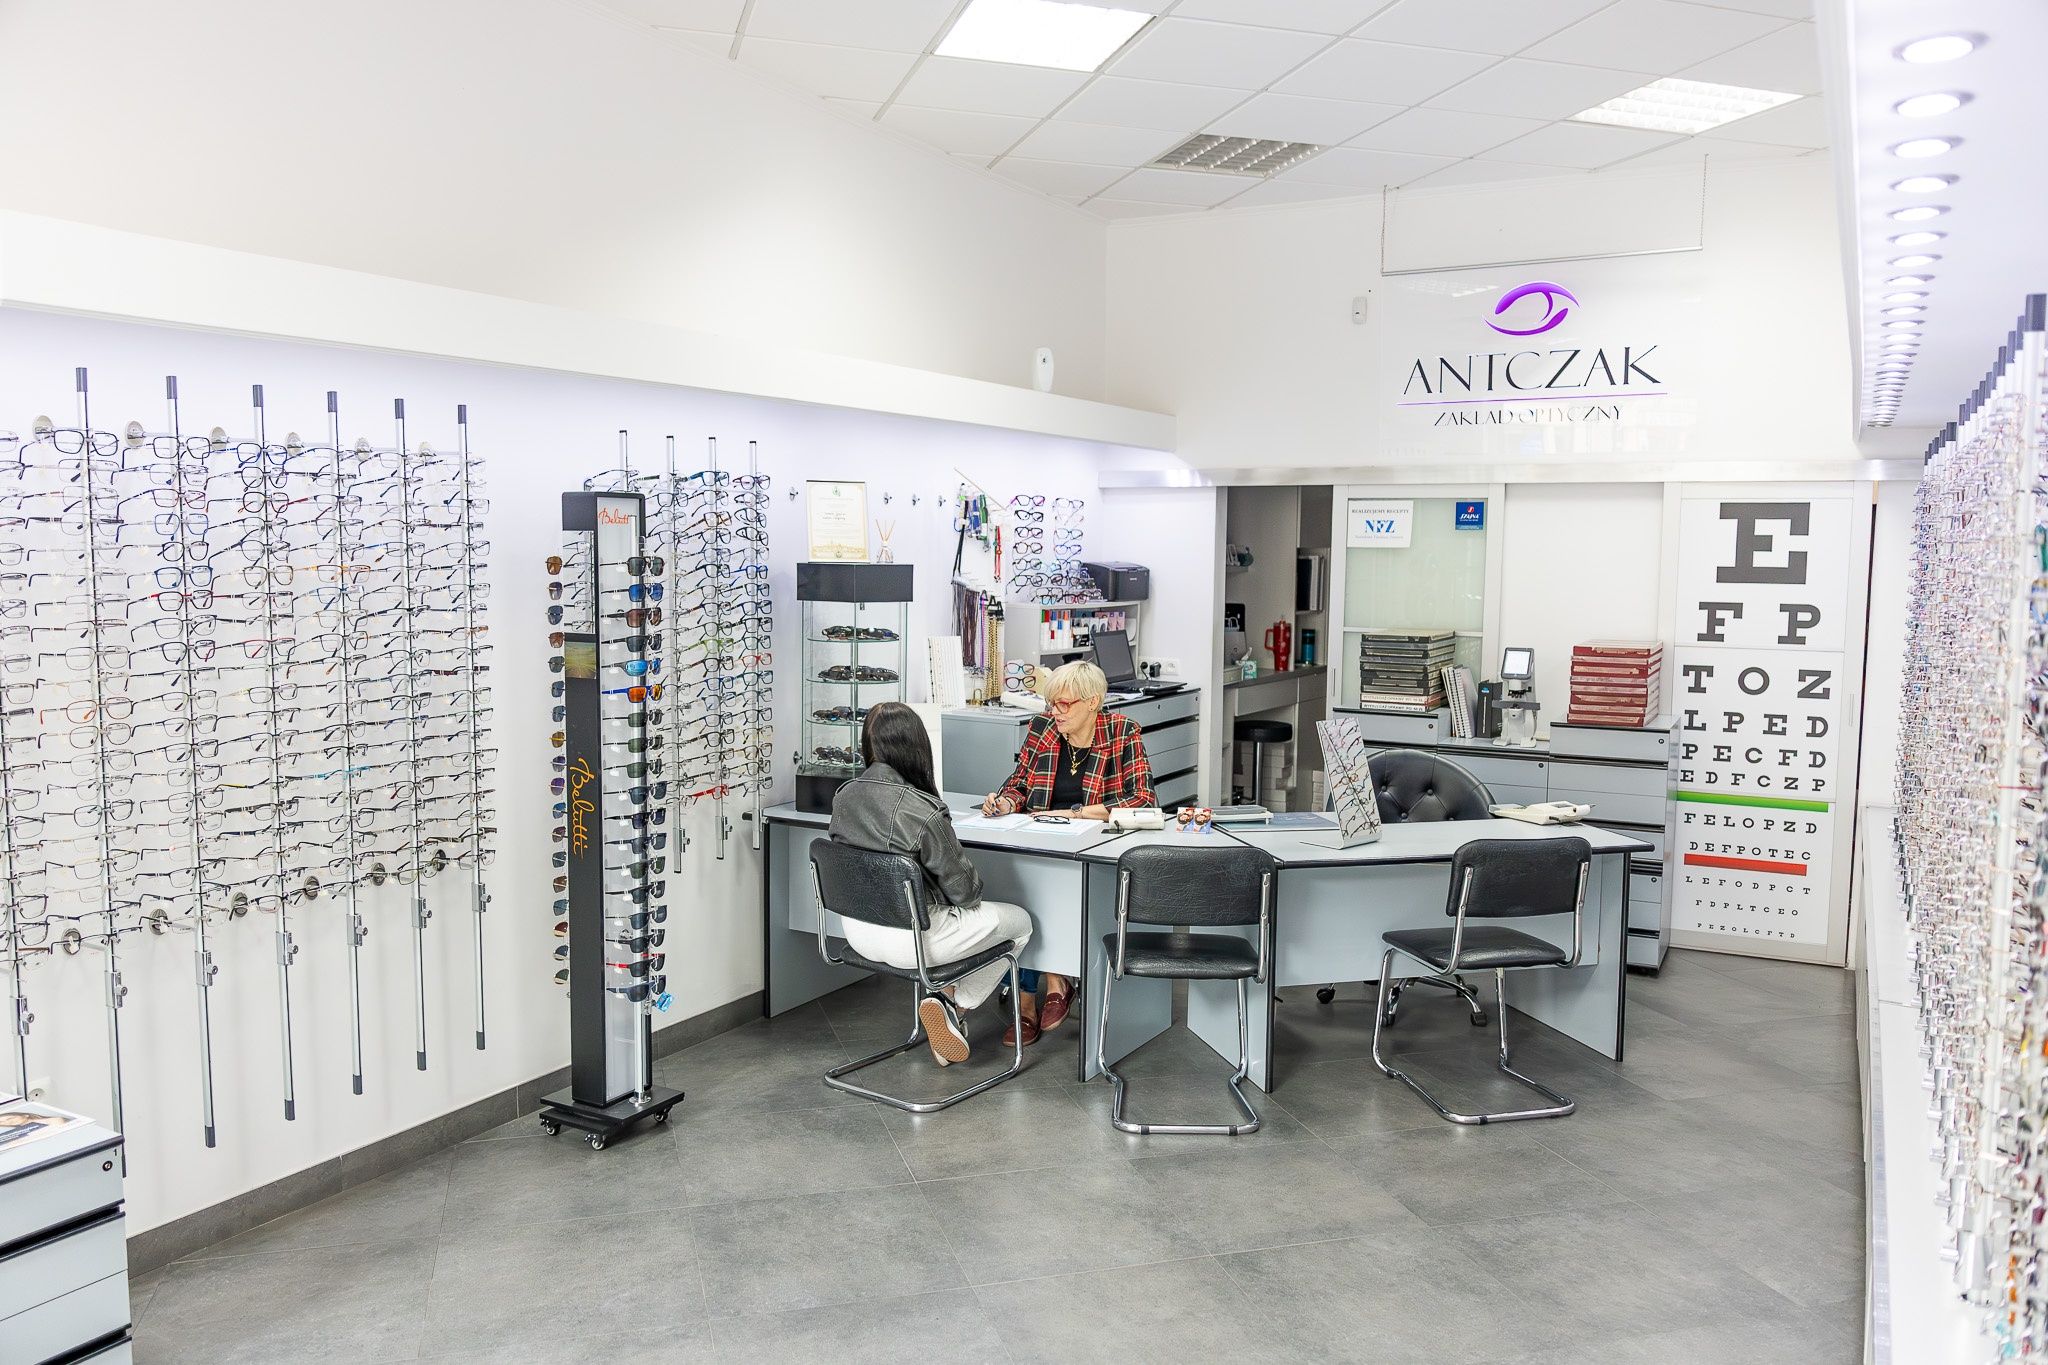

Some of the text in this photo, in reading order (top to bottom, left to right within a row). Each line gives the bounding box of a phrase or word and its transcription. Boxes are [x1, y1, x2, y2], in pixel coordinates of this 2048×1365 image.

[1403, 345, 1662, 395] ANTCZAK
[1518, 405, 1623, 423] OPTYCZNY
[1365, 519, 1395, 533] NFZ
[1715, 501, 1811, 585] E
[570, 757, 595, 859] Belutti
